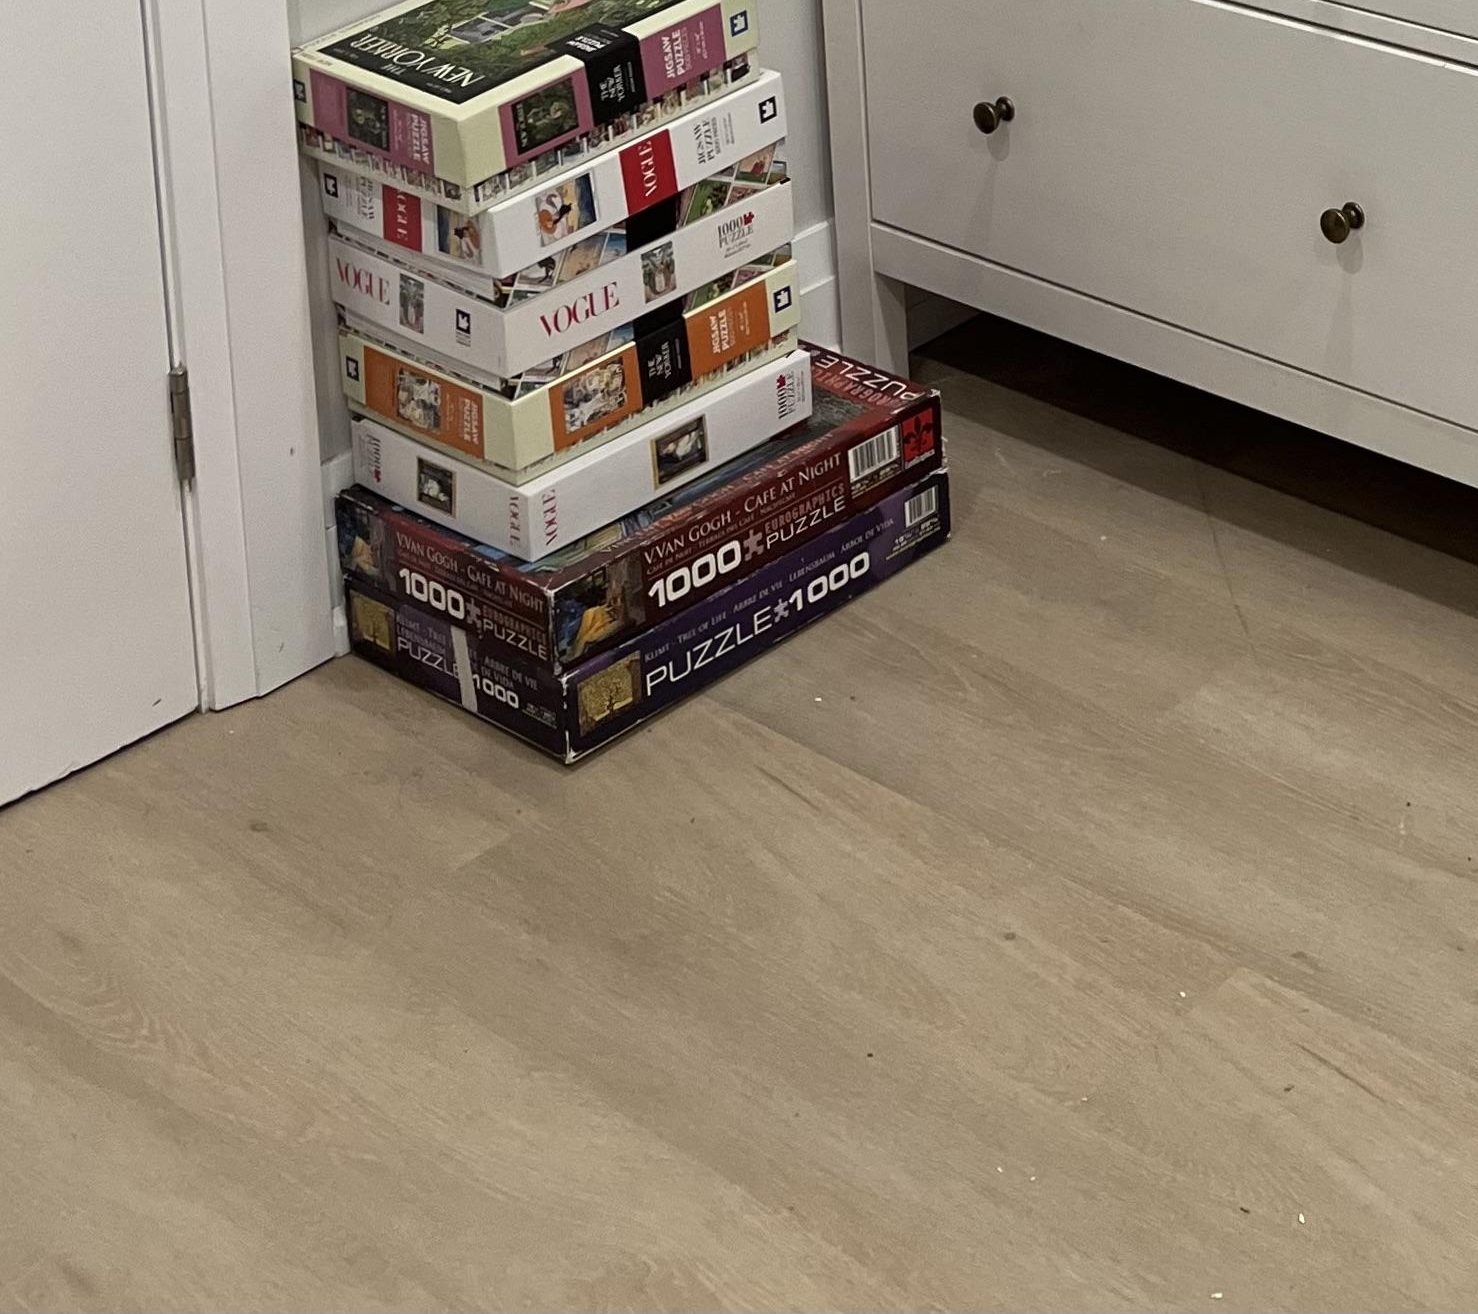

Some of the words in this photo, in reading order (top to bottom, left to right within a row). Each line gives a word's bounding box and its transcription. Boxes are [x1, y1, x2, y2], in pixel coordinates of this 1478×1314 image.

[350, 33, 436, 72] YORKER
[432, 62, 486, 88] NEW
[661, 36, 677, 79] JIGSAW
[671, 29, 687, 76] PUZZLE
[693, 124, 707, 164] JIGSAW
[702, 120, 715, 162] PUZZLE
[637, 141, 657, 197] VOGUE
[718, 216, 744, 238] 1000
[336, 257, 390, 305] VOGUE
[539, 281, 620, 336] VOGUE
[717, 308, 730, 350] PUZZLE
[709, 315, 722, 354] JIGSAW
[815, 354, 925, 401] PUZZLE
[542, 489, 558, 546] VOGUE
[688, 511, 731, 542] GOGH
[744, 487, 777, 513] CAFE
[780, 479, 795, 496] AT
[799, 453, 842, 486] NIGHT
[764, 482, 846, 535] EUROGRAPHICS
[508, 495, 521, 550] VOGUE
[648, 540, 741, 608] 1000
[766, 495, 846, 550] PUZZLE
[426, 546, 458, 573] GOGH
[467, 564, 493, 589] CAFE
[494, 576, 506, 590] AT
[509, 581, 544, 613] NIGHT
[400, 567, 465, 620] 1000
[483, 618, 548, 661] PUZZLE
[644, 643, 671, 662] KLIMT
[677, 629, 697, 645] TREE
[711, 612, 728, 628] LIFE
[733, 596, 757, 614] ARBRE
[645, 606, 773, 698] PUZZLE
[788, 551, 870, 612] 1000
[473, 673, 519, 709] 1000
